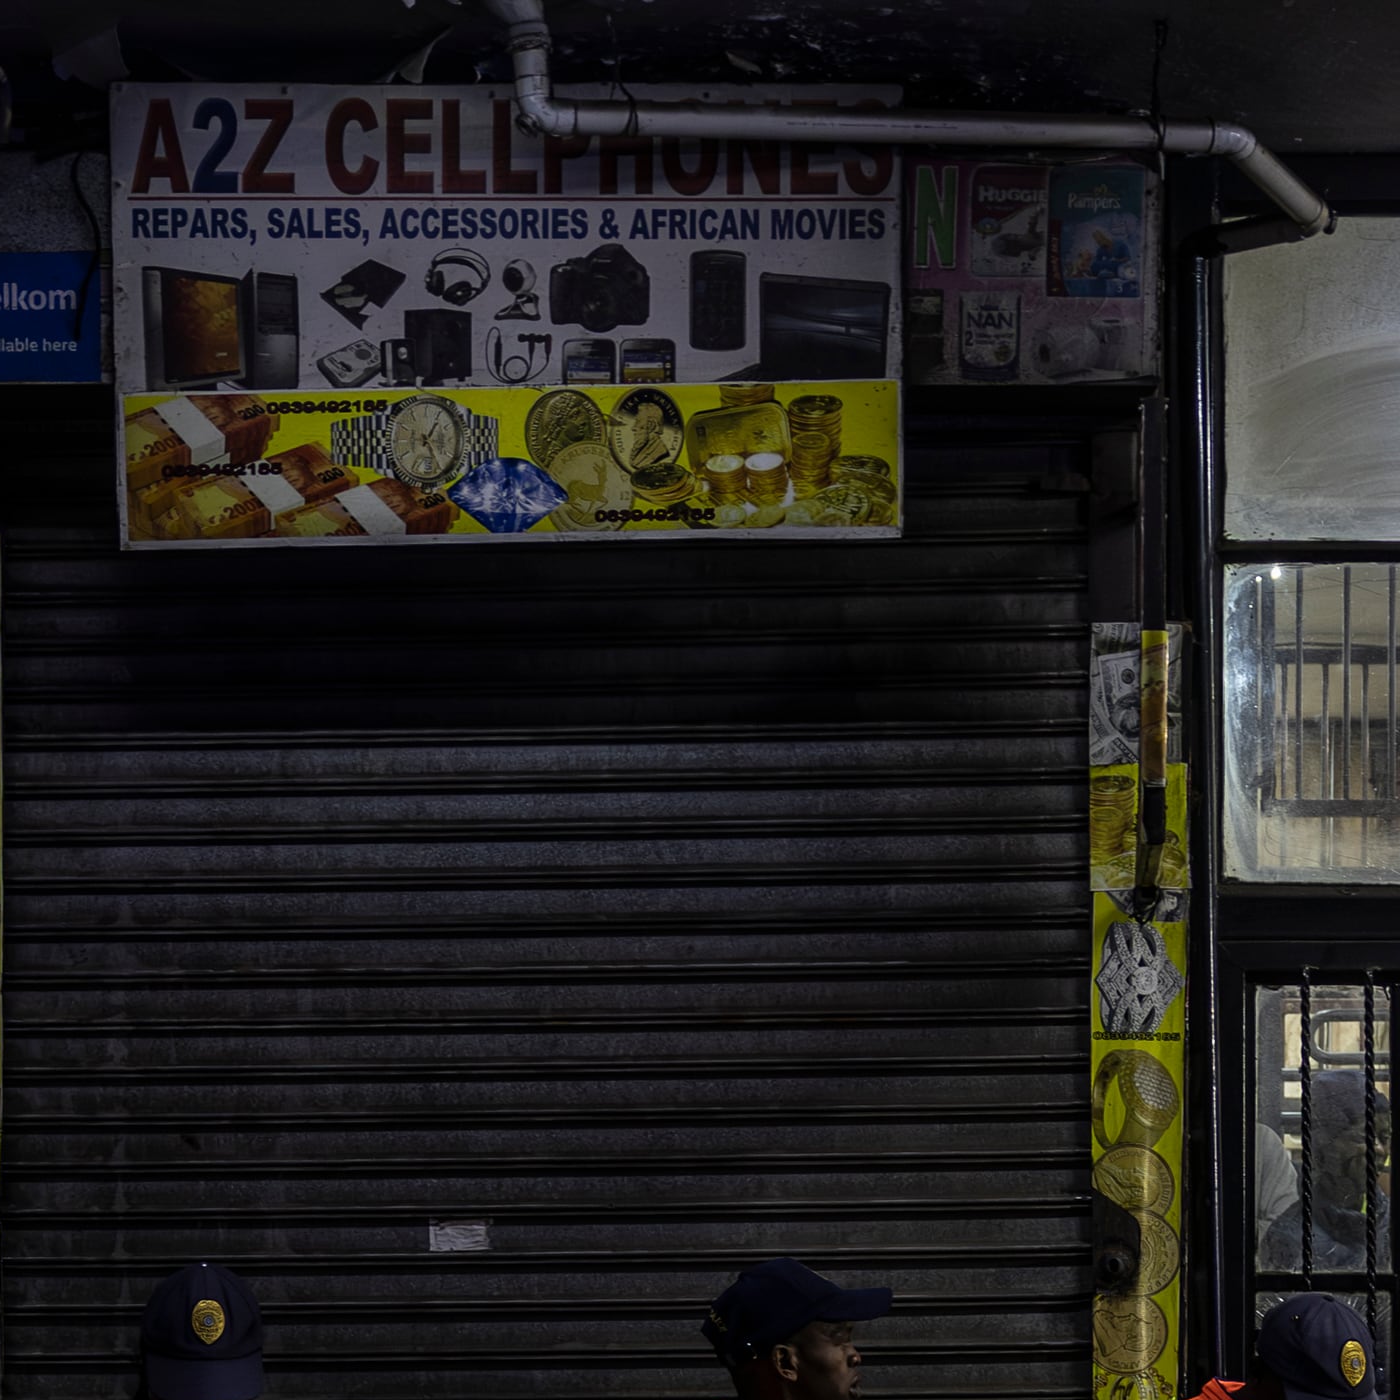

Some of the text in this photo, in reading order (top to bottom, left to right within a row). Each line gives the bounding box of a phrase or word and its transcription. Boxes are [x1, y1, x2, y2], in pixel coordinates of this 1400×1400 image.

[131, 97, 894, 196] A2Z CELLPHONES
[1068, 191, 1121, 213] Pampers
[132, 208, 885, 245] REPARS, SALES, ACCESSORIES & AFRICAN MOVIES
[913, 166, 958, 268] N
[967, 312, 1013, 328] NAN
[42, 338, 78, 352] here
[318, 467, 345, 484] 200
[418, 493, 446, 509] 200
